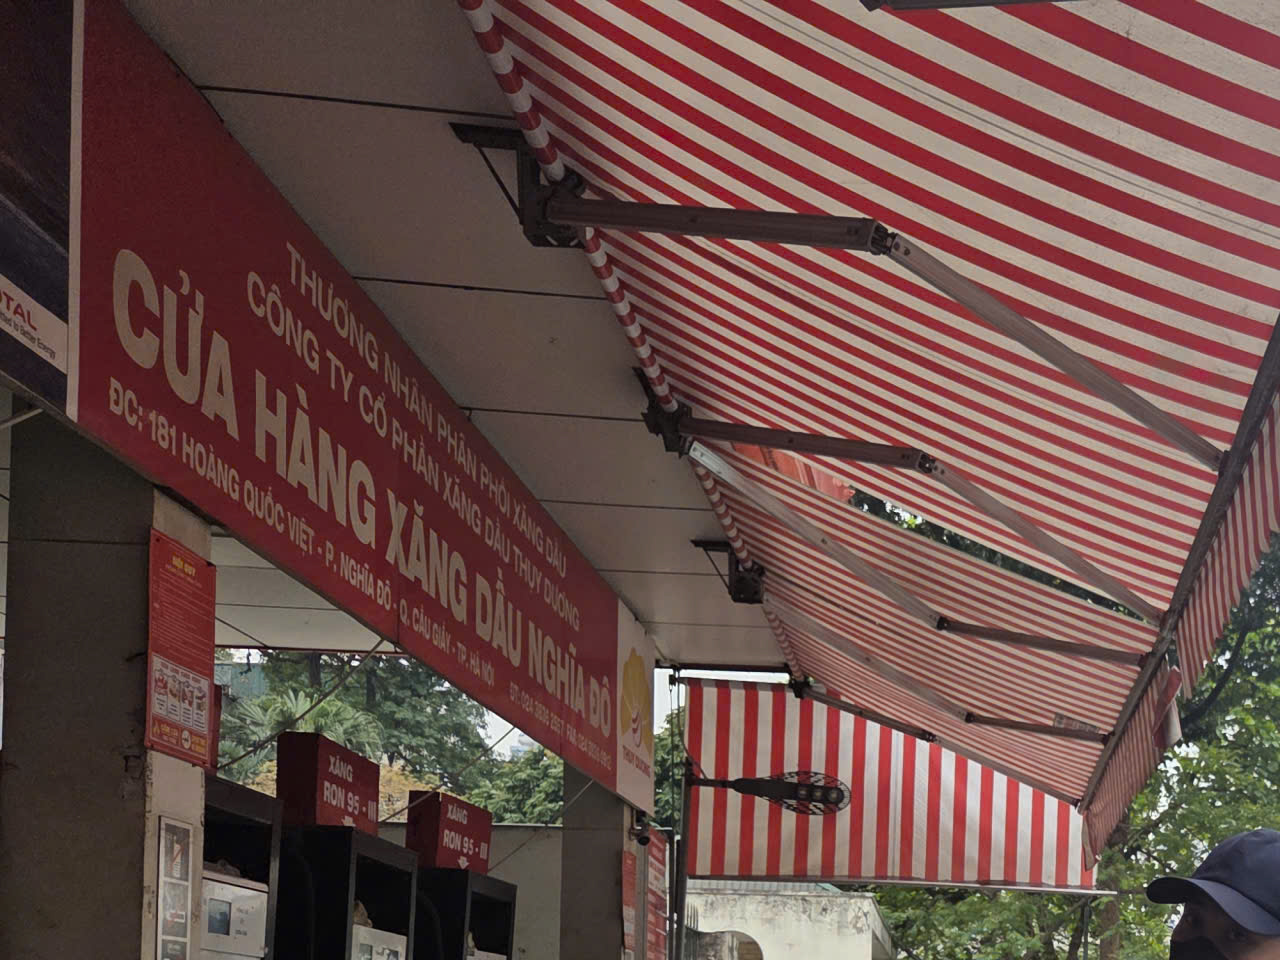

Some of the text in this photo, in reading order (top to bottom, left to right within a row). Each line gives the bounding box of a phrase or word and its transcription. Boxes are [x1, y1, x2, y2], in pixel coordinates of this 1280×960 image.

[247, 271, 320, 374] CÔNG
[326, 349, 354, 403] TY
[359, 385, 387, 438] CỔ
[392, 417, 440, 493] PHẦN
[443, 471, 481, 535] XĂNG
[485, 516, 510, 564] DẦU
[544, 577, 580, 632] DƯƠNG
[286, 240, 567, 578] THƯƠNG NHÂN PHÂN PHỐI XĂNG DẦU
[109, 376, 143, 432] ĐC:
[149, 409, 177, 456] 181
[182, 431, 240, 502] HOÀNG
[243, 479, 285, 534] QUỐC
[287, 511, 315, 556] VIỆT
[340, 552, 375, 599] NGHĨA
[376, 579, 392, 611] ĐÔ
[400, 599, 410, 626] Q.
[412, 604, 431, 640] CẦU
[432, 621, 451, 654] GIẤY
[112, 249, 611, 738] CỬA HÀNG XĂNG DẦU NGHĨA ĐÔ
[323, 780, 345, 809] RON
[347, 792, 360, 816] 95
[328, 755, 353, 782] XĂNG
[443, 829, 461, 852] RON
[463, 836, 474, 856] 95
[447, 803, 468, 825] XĂNG
